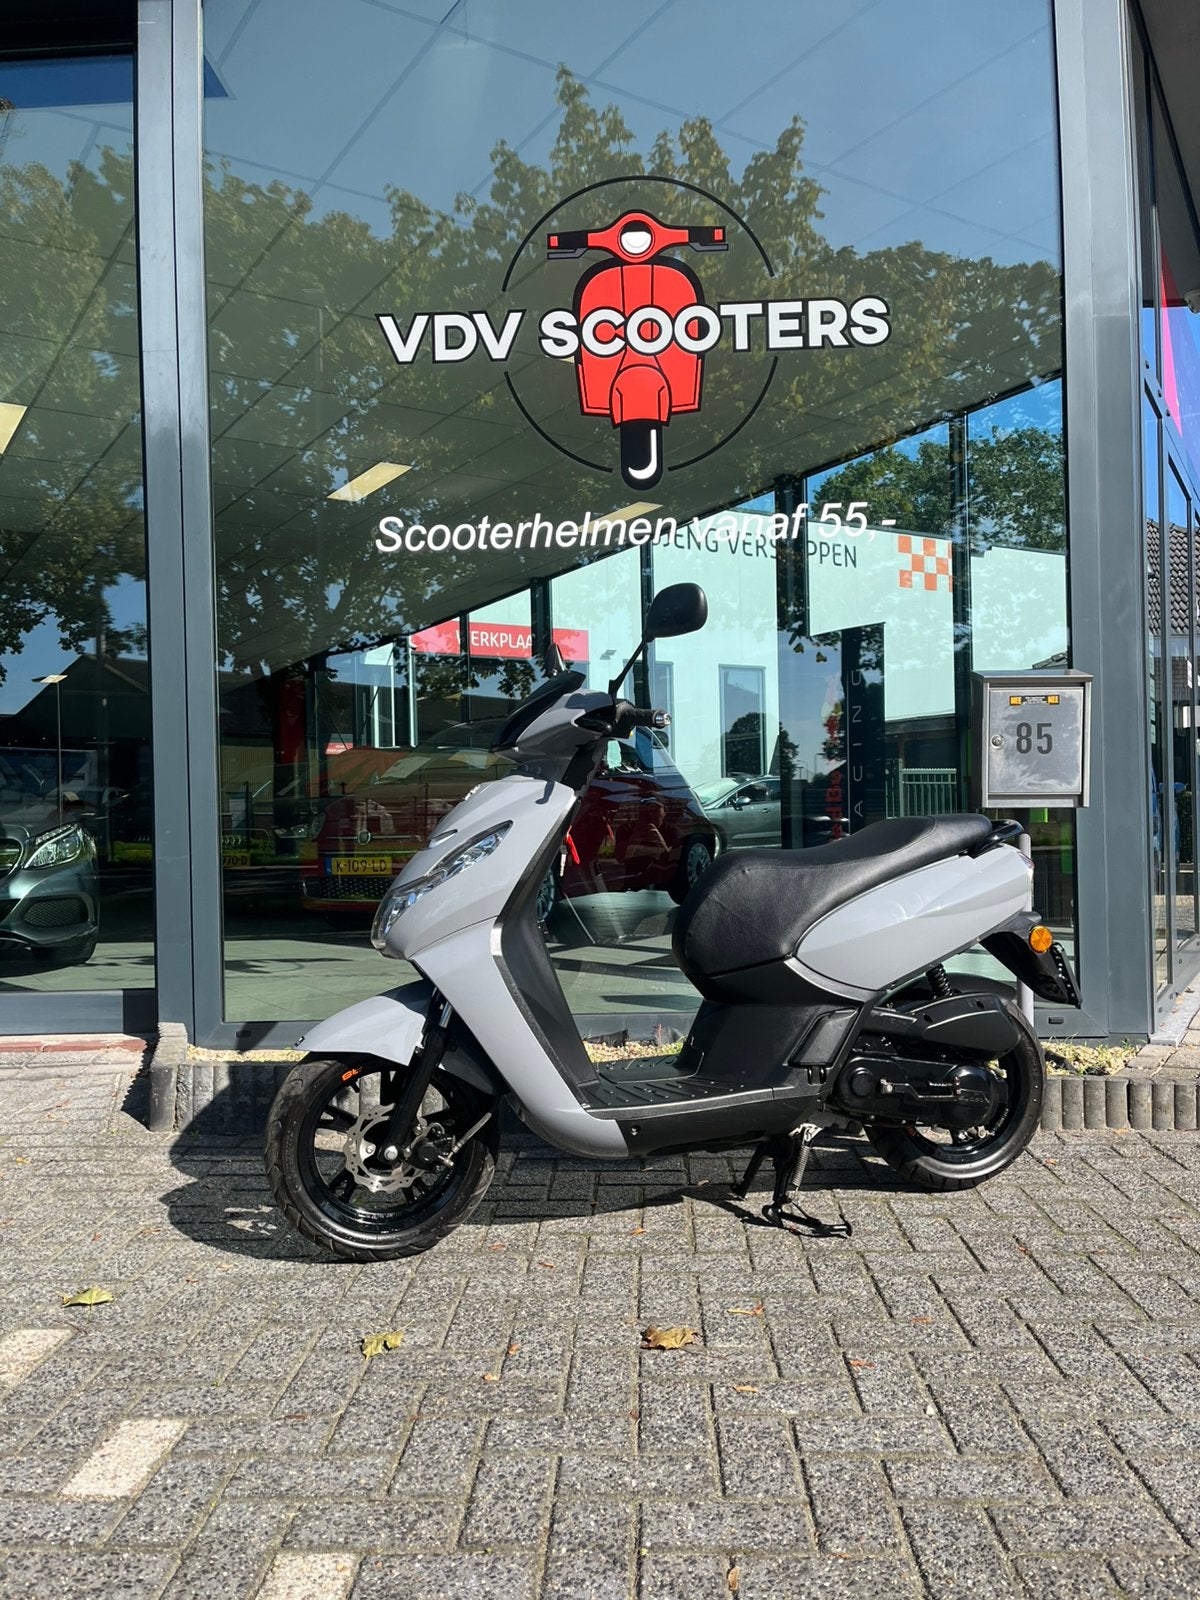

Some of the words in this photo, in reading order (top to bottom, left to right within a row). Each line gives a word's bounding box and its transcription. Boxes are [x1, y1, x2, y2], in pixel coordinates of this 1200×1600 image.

[377, 310, 524, 364] VDV
[539, 298, 891, 358] SCOOTERS
[375, 511, 677, 553] Scooterhelmen
[694, 504, 808, 542] vanaf
[818, 502, 897, 541] 55,-
[653, 524, 718, 552] JENG
[727, 530, 857, 568] VERPPEN
[456, 629, 532, 649] ERKPLAA
[850, 669, 863, 818] ACING
[1016, 722, 1053, 755] 85
[336, 860, 387, 873] K-109-LD
